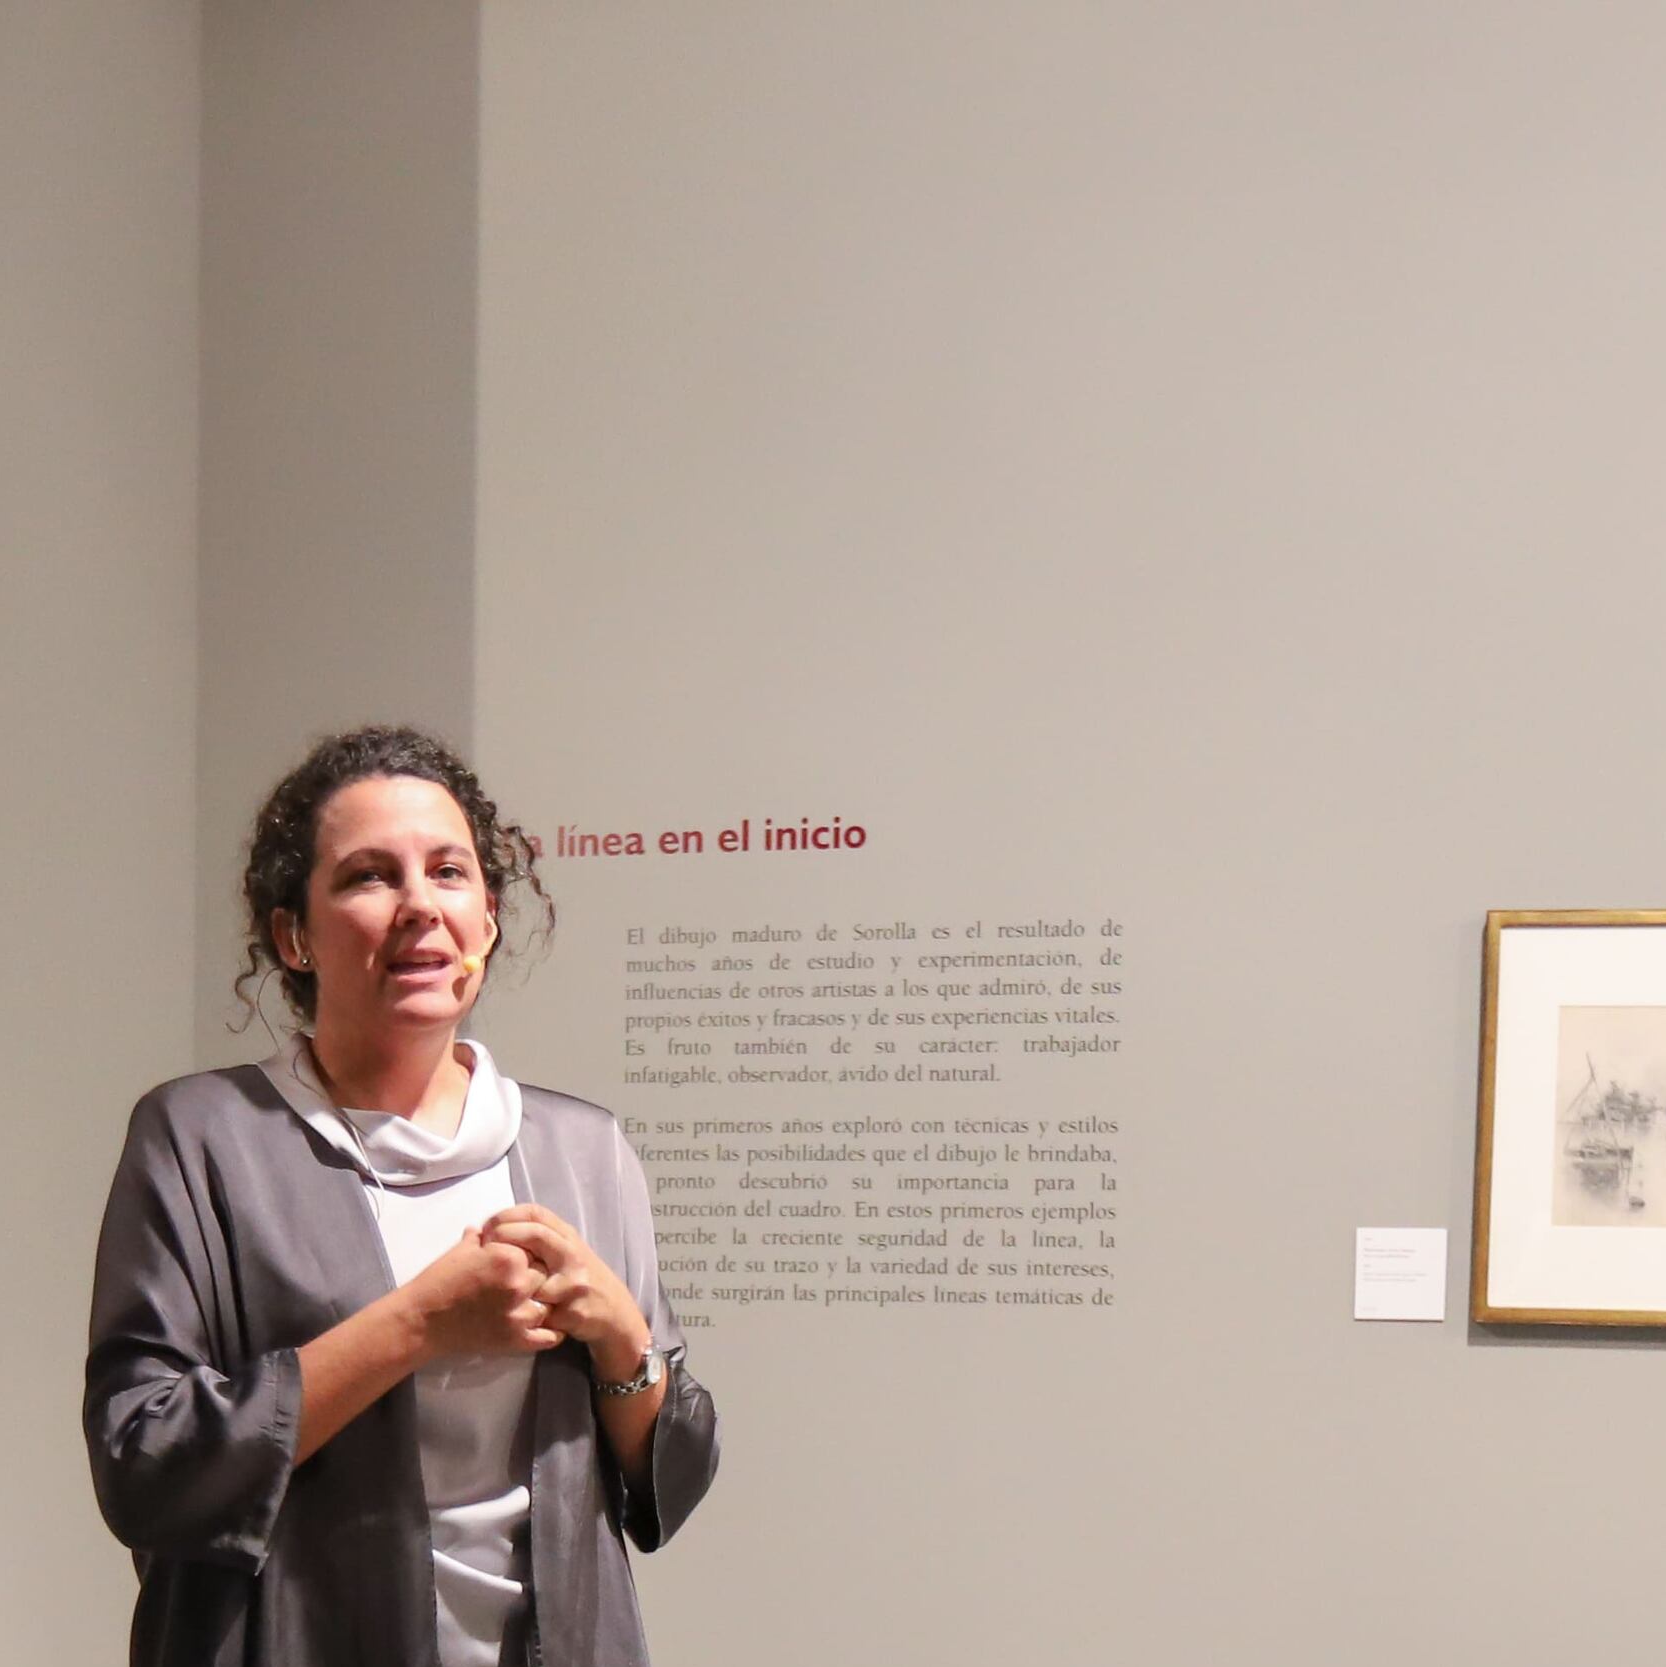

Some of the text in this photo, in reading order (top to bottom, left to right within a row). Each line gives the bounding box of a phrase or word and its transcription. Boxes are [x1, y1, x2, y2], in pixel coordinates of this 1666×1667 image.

[557, 824, 646, 857] línea
[658, 831, 704, 855] en
[717, 819, 750, 852] el
[764, 816, 867, 852] inicio
[627, 918, 1124, 949] El dibujo maduro de Sorolla es el resultado de
[626, 955, 697, 973] muchos
[711, 956, 754, 971] años
[768, 952, 791, 970] de
[806, 950, 875, 970] estudio
[890, 956, 902, 973] y
[1099, 947, 1123, 966] de
[625, 982, 722, 1000] influencias
[728, 981, 751, 999] de
[757, 986, 805, 998] otros
[810, 982, 878, 998] artistas
[883, 985, 895, 997] a
[902, 979, 930, 996] los
[936, 983, 971, 1001] que
[1059, 976, 1083, 995] de
[1090, 981, 1123, 995] sus
[625, 1005, 1120, 1033] propios éxitos y fracasos y de sus experiencias vitales.
[625, 1040, 646, 1056] Es
[667, 1037, 712, 1055] fruto
[734, 1037, 808, 1055] también
[829, 1036, 852, 1054] de
[874, 1041, 896, 1054] su
[1023, 1034, 1122, 1057] trabajador
[624, 1064, 1001, 1088] infatigable, observador, ávido del natural.
[623, 1114, 1119, 1139] En sus primeros años exploró con técnicas y estilos
[635, 1143, 1118, 1167] ferentes las posibilidades que el dibujo le brindaba,
[656, 1171, 1117, 1196] pronto descubrió su importancia para la
[743, 1199, 772, 1217] del
[778, 1199, 845, 1218] cuadro.
[854, 1201, 880, 1217] En
[886, 1204, 933, 1219] estos
[940, 1203, 1025, 1225] primeros
[1030, 1202, 1117, 1224] ejemplos
[732, 1227, 748, 1245] la
[761, 1230, 843, 1246] creciente
[857, 1229, 948, 1251] seguridad
[962, 1228, 985, 1247] de
[1000, 1229, 1017, 1247] la
[1099, 1230, 1116, 1248] la
[714, 1255, 737, 1273] de
[744, 1261, 766, 1272] su
[773, 1260, 819, 1273] trazo
[827, 1262, 838, 1278] y
[846, 1256, 862, 1273] la
[869, 1255, 949, 1275] variedad
[956, 1257, 979, 1275] de
[987, 1264, 1018, 1276] sus
[1026, 1260, 1115, 1280] intereses,
[711, 1285, 785, 1306] surgirán
[793, 1283, 818, 1301] las
[824, 1284, 926, 1308] principales
[933, 1284, 988, 1304] líneas
[995, 1287, 1084, 1305] temáticas
[1090, 1287, 1114, 1306] de
